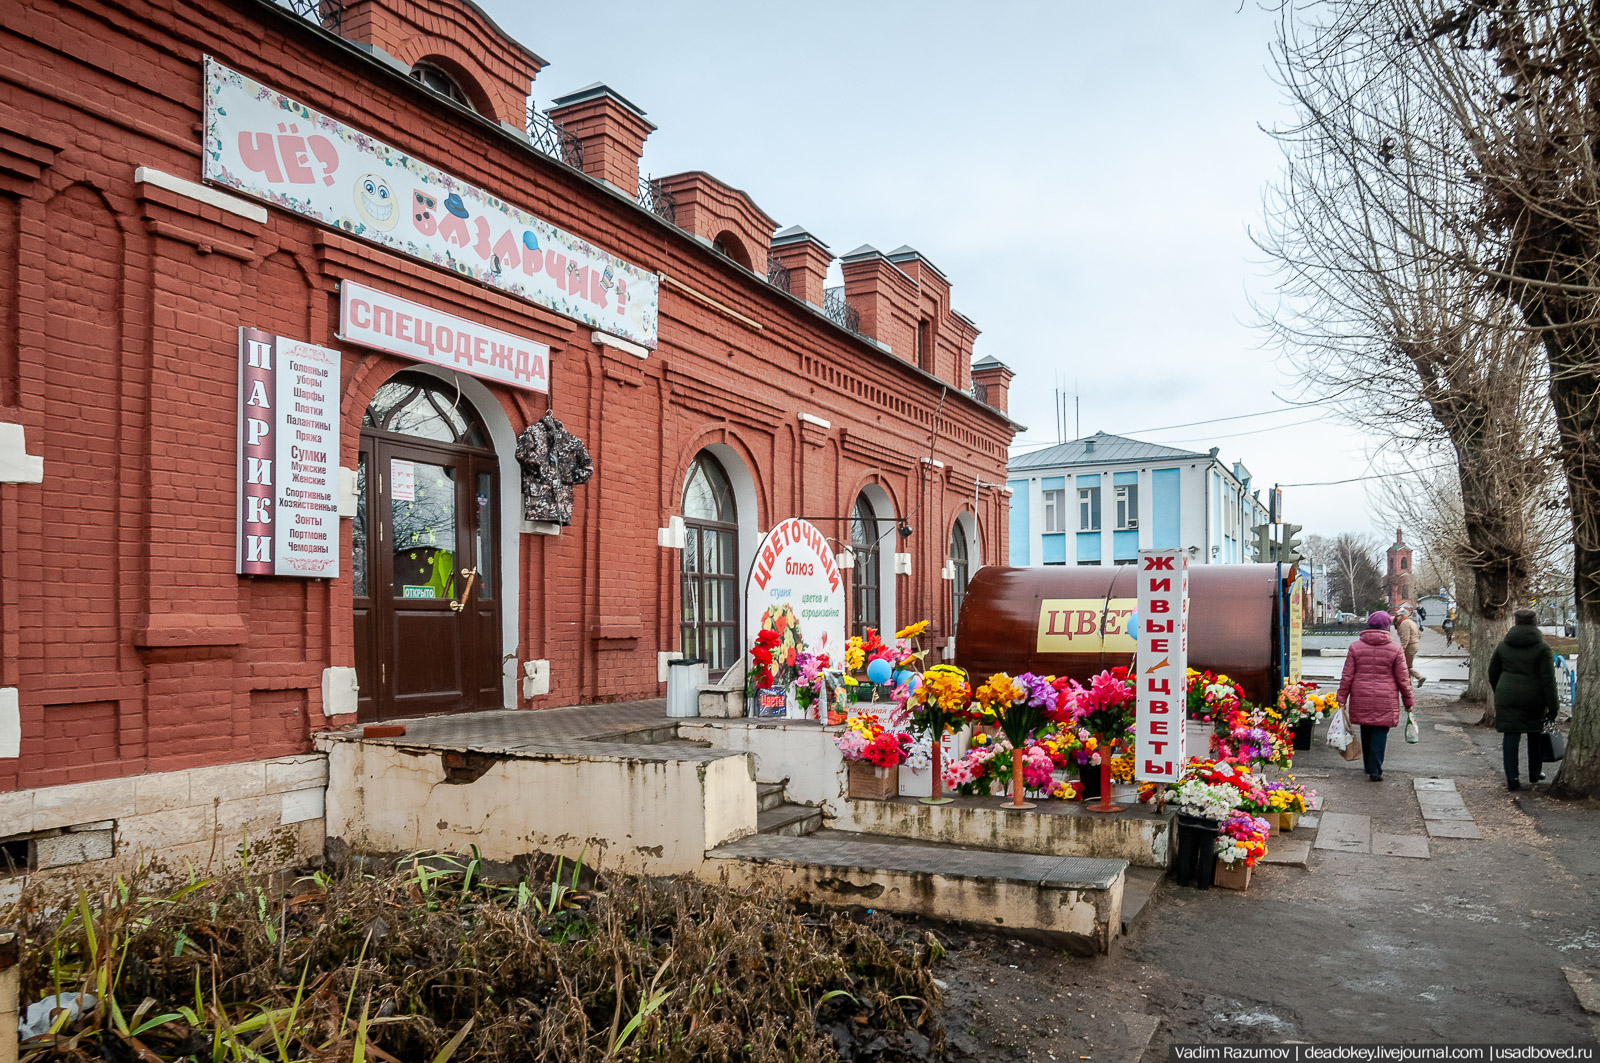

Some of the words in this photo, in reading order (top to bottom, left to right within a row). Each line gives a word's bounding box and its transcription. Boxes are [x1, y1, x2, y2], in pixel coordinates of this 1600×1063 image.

[238, 122, 339, 187] ЧЁ?
[350, 298, 546, 382] СПЕЦОДЕЖДА
[290, 360, 328, 378] Головные
[296, 375, 322, 388] уборы
[293, 387, 325, 402] Шарфы
[295, 402, 323, 416] Платки
[286, 414, 331, 431] Палантины
[296, 430, 322, 443] Пряжа
[246, 340, 272, 562] ПАРИКИ
[291, 445, 327, 463] Сумки
[291, 461, 326, 474] Мужские
[292, 473, 326, 486] Женские
[285, 487, 332, 501] Спортивные
[279, 498, 338, 512] Хозяйственные
[295, 513, 322, 526] Зонты
[289, 528, 327, 540] Портмоне
[288, 541, 329, 553] Чемоданы
[754, 520, 840, 593] ЦВЕТОЧНЫЙ
[785, 557, 814, 576] блюз
[405, 588, 434, 598] ОТКРЫТО
[769, 588, 792, 600] студия
[801, 594, 823, 605] цветов
[824, 595, 829, 603] и
[1144, 556, 1175, 652] ЖИВЫЕ
[801, 608, 840, 620] аэродизайна
[1145, 678, 1173, 775] ЦВЕТЫ
